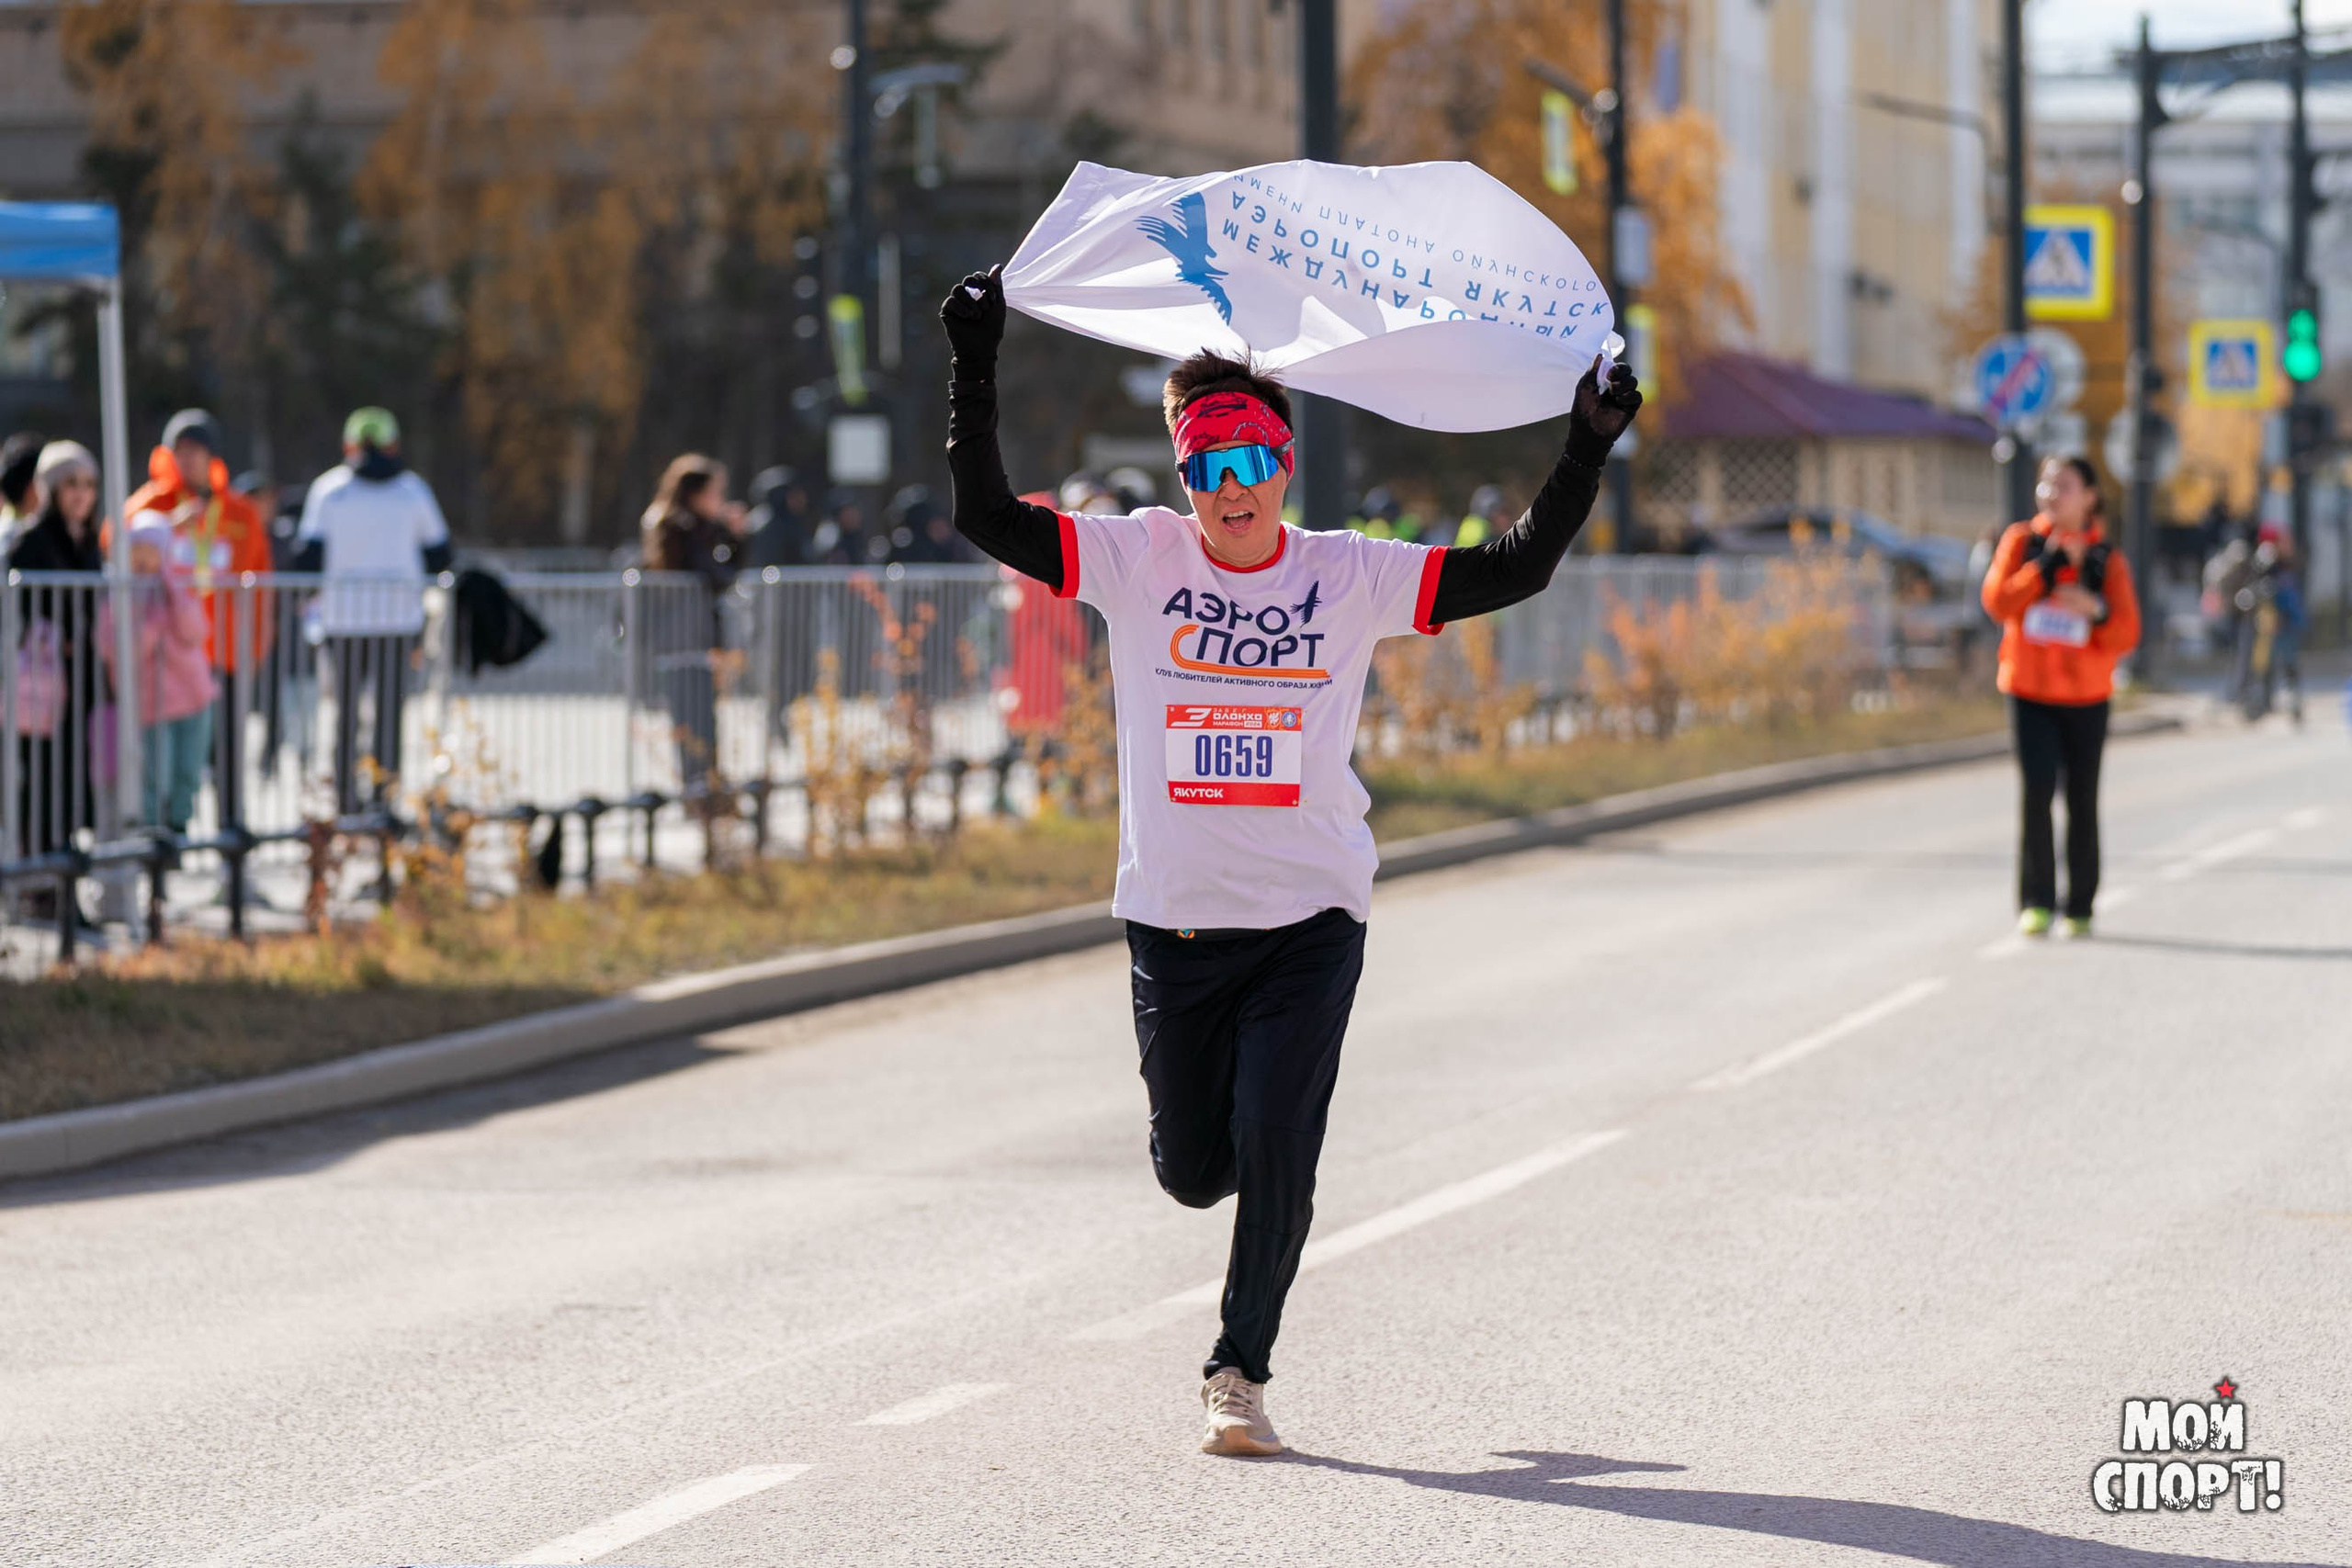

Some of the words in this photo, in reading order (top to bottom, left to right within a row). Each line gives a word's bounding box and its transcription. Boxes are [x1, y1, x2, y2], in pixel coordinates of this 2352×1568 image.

[1162, 587, 1290, 636] АЭРО
[1170, 624, 1330, 678] СПОРТ
[1156, 668, 1172, 677] КЛУБ
[1173, 671, 1222, 683] ЛЮБИТЕЛЕЙ
[1224, 678, 1275, 688] АКТИВНОГО
[1277, 681, 1306, 689] ОБРАЗА
[1213, 713, 1262, 721] ОЛОНХО
[1195, 734, 1272, 777] 0659
[1173, 787, 1224, 798] ЯКУТСК
